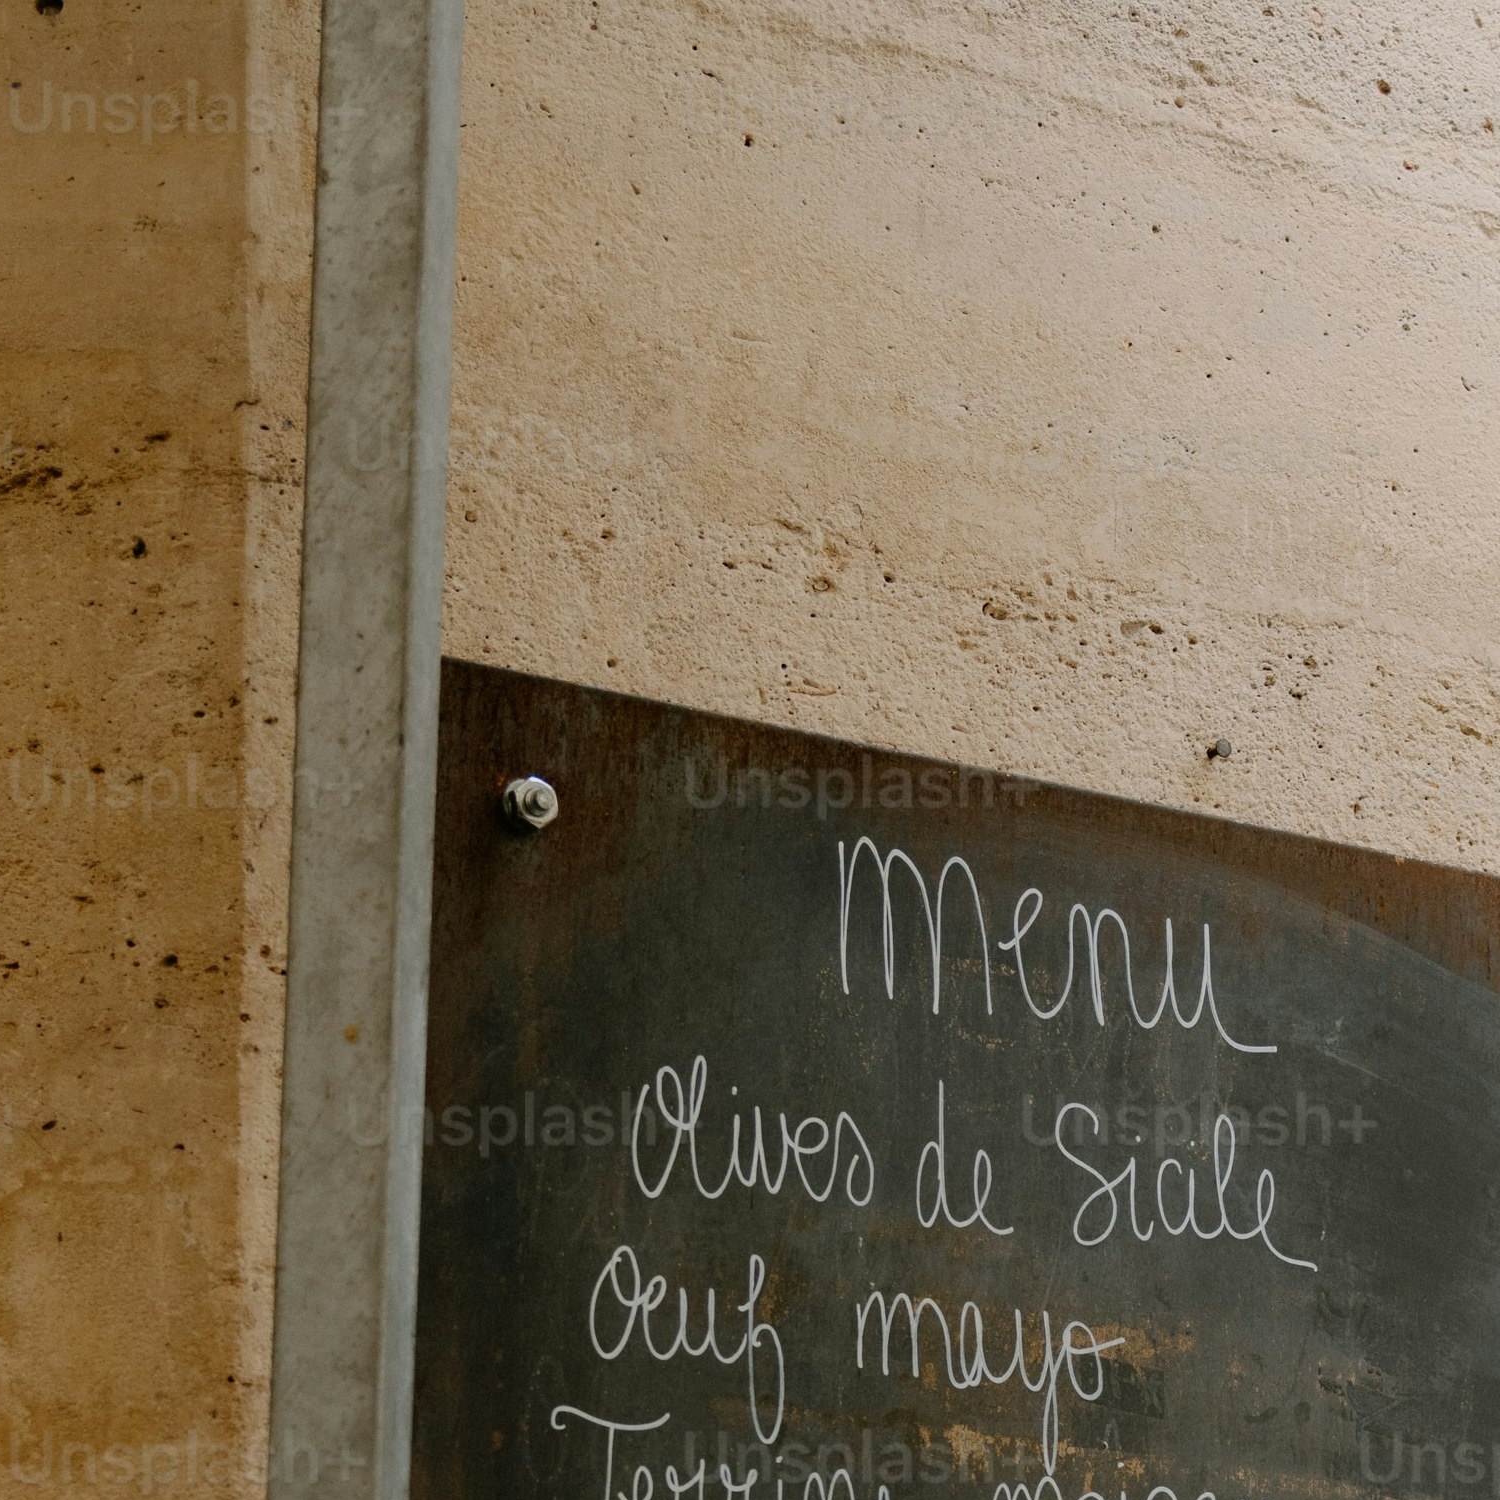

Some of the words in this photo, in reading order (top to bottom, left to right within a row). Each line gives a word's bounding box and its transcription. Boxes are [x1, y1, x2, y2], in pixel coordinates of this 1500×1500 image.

[837, 835, 1278, 1053] Menu
[632, 1055, 876, 1207] Olives
[915, 1079, 1014, 1235] de
[1055, 1102, 1318, 1272] Sicile
[855, 1291, 1125, 1477] mayo
